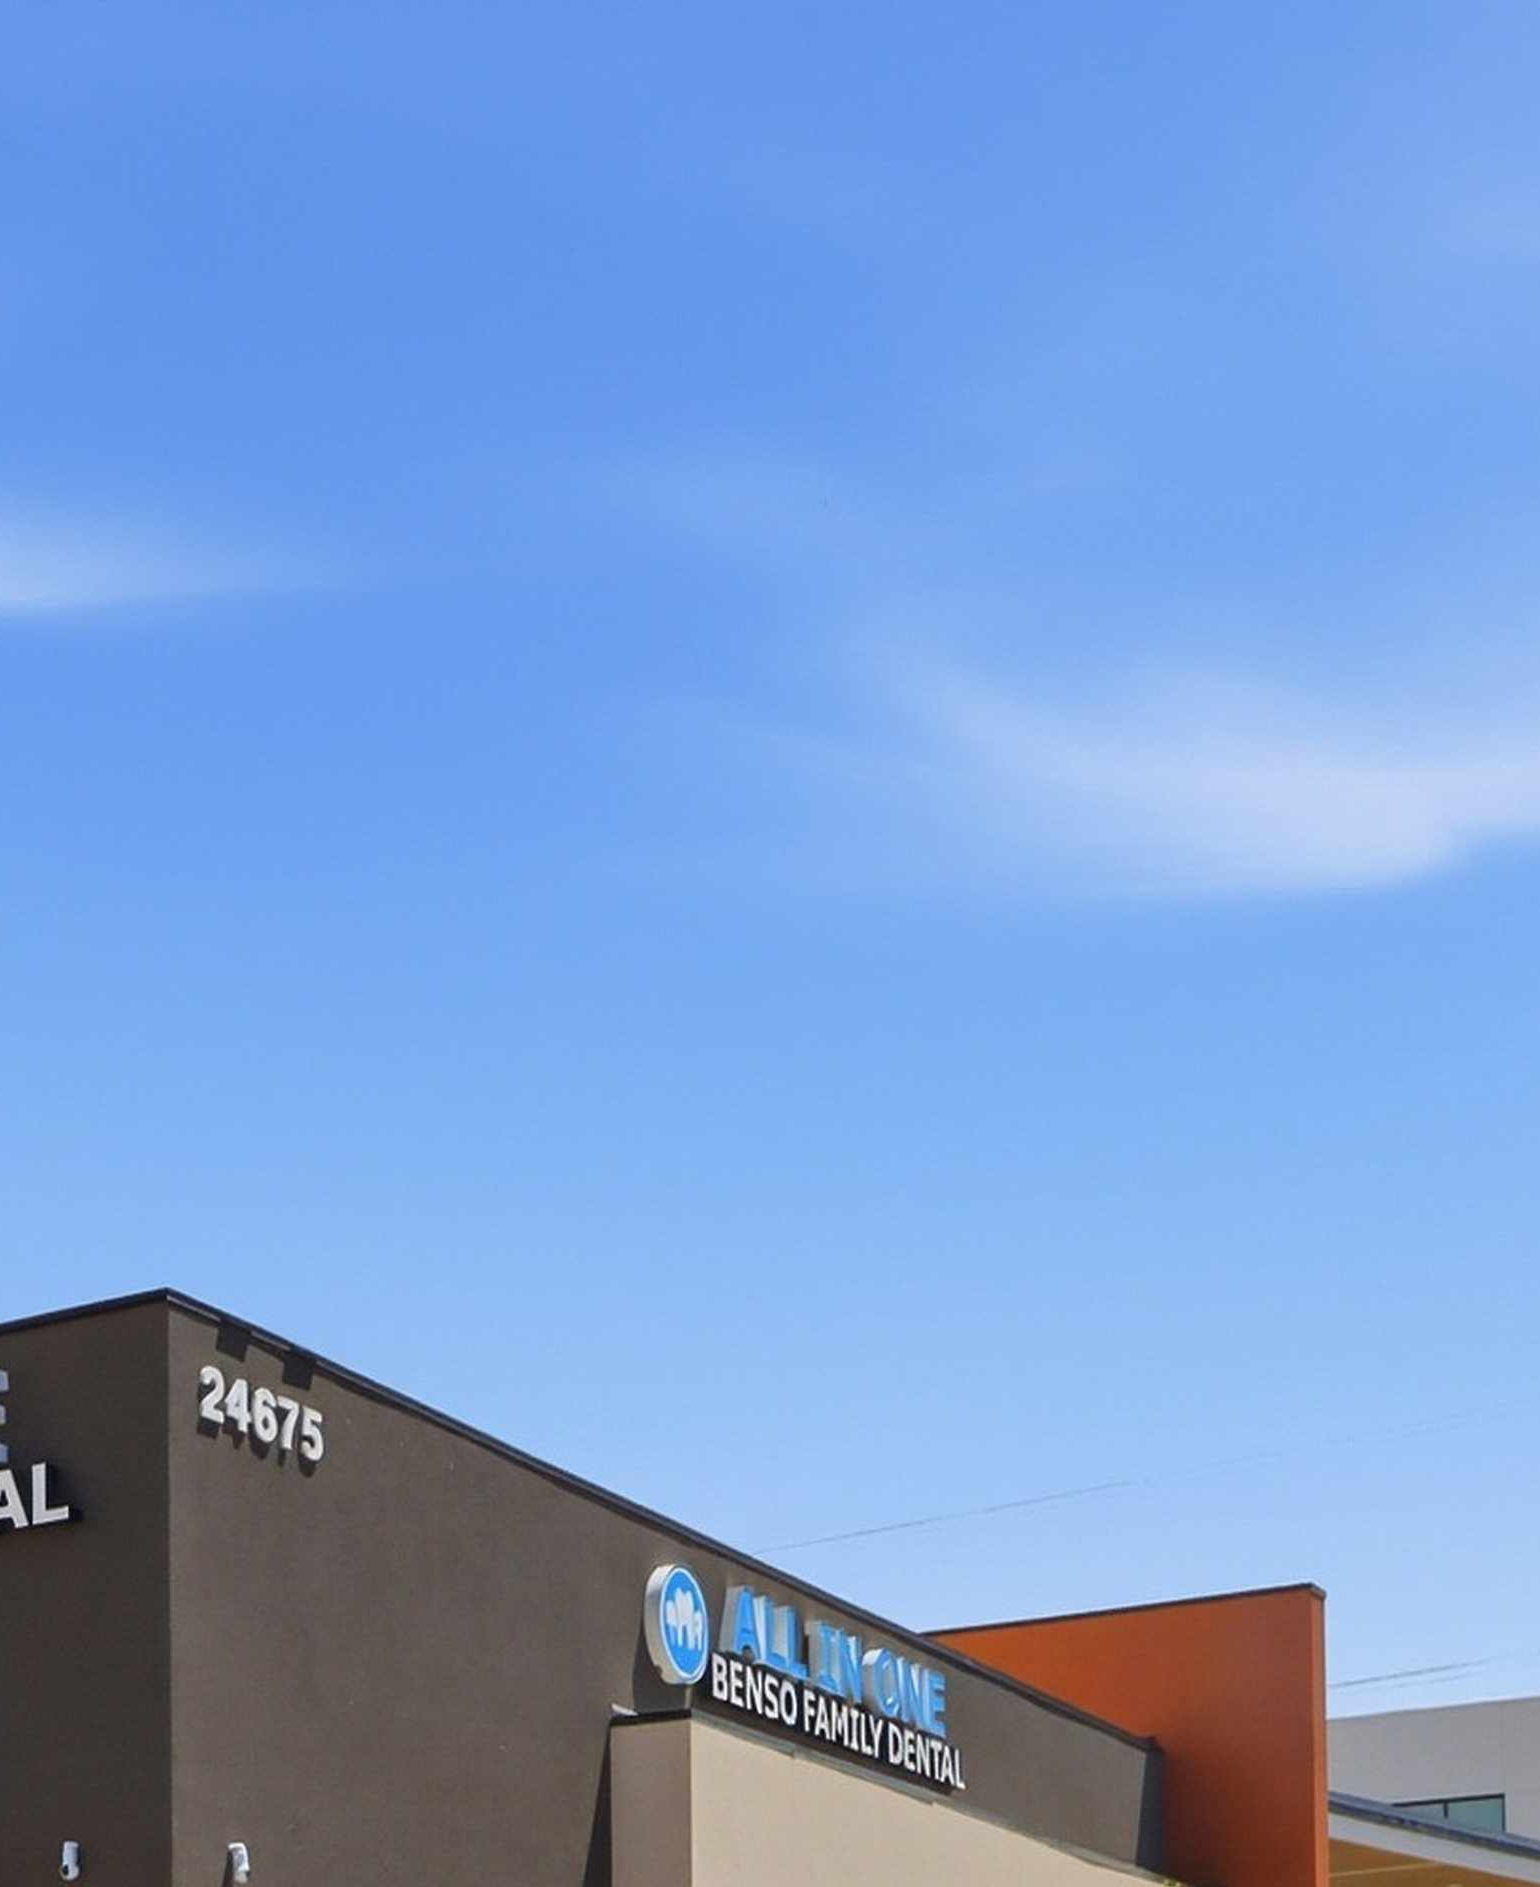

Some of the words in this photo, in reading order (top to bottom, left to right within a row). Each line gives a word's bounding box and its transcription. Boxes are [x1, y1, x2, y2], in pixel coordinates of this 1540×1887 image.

[199, 1366, 324, 1462] 24675
[711, 1653, 798, 1726] BENSO
[802, 1690, 883, 1759] FAMILY
[888, 1722, 966, 1790] DENTAL
[719, 1585, 811, 1681] ALL
[805, 1620, 864, 1704] IN
[861, 1648, 947, 1739] ONE
